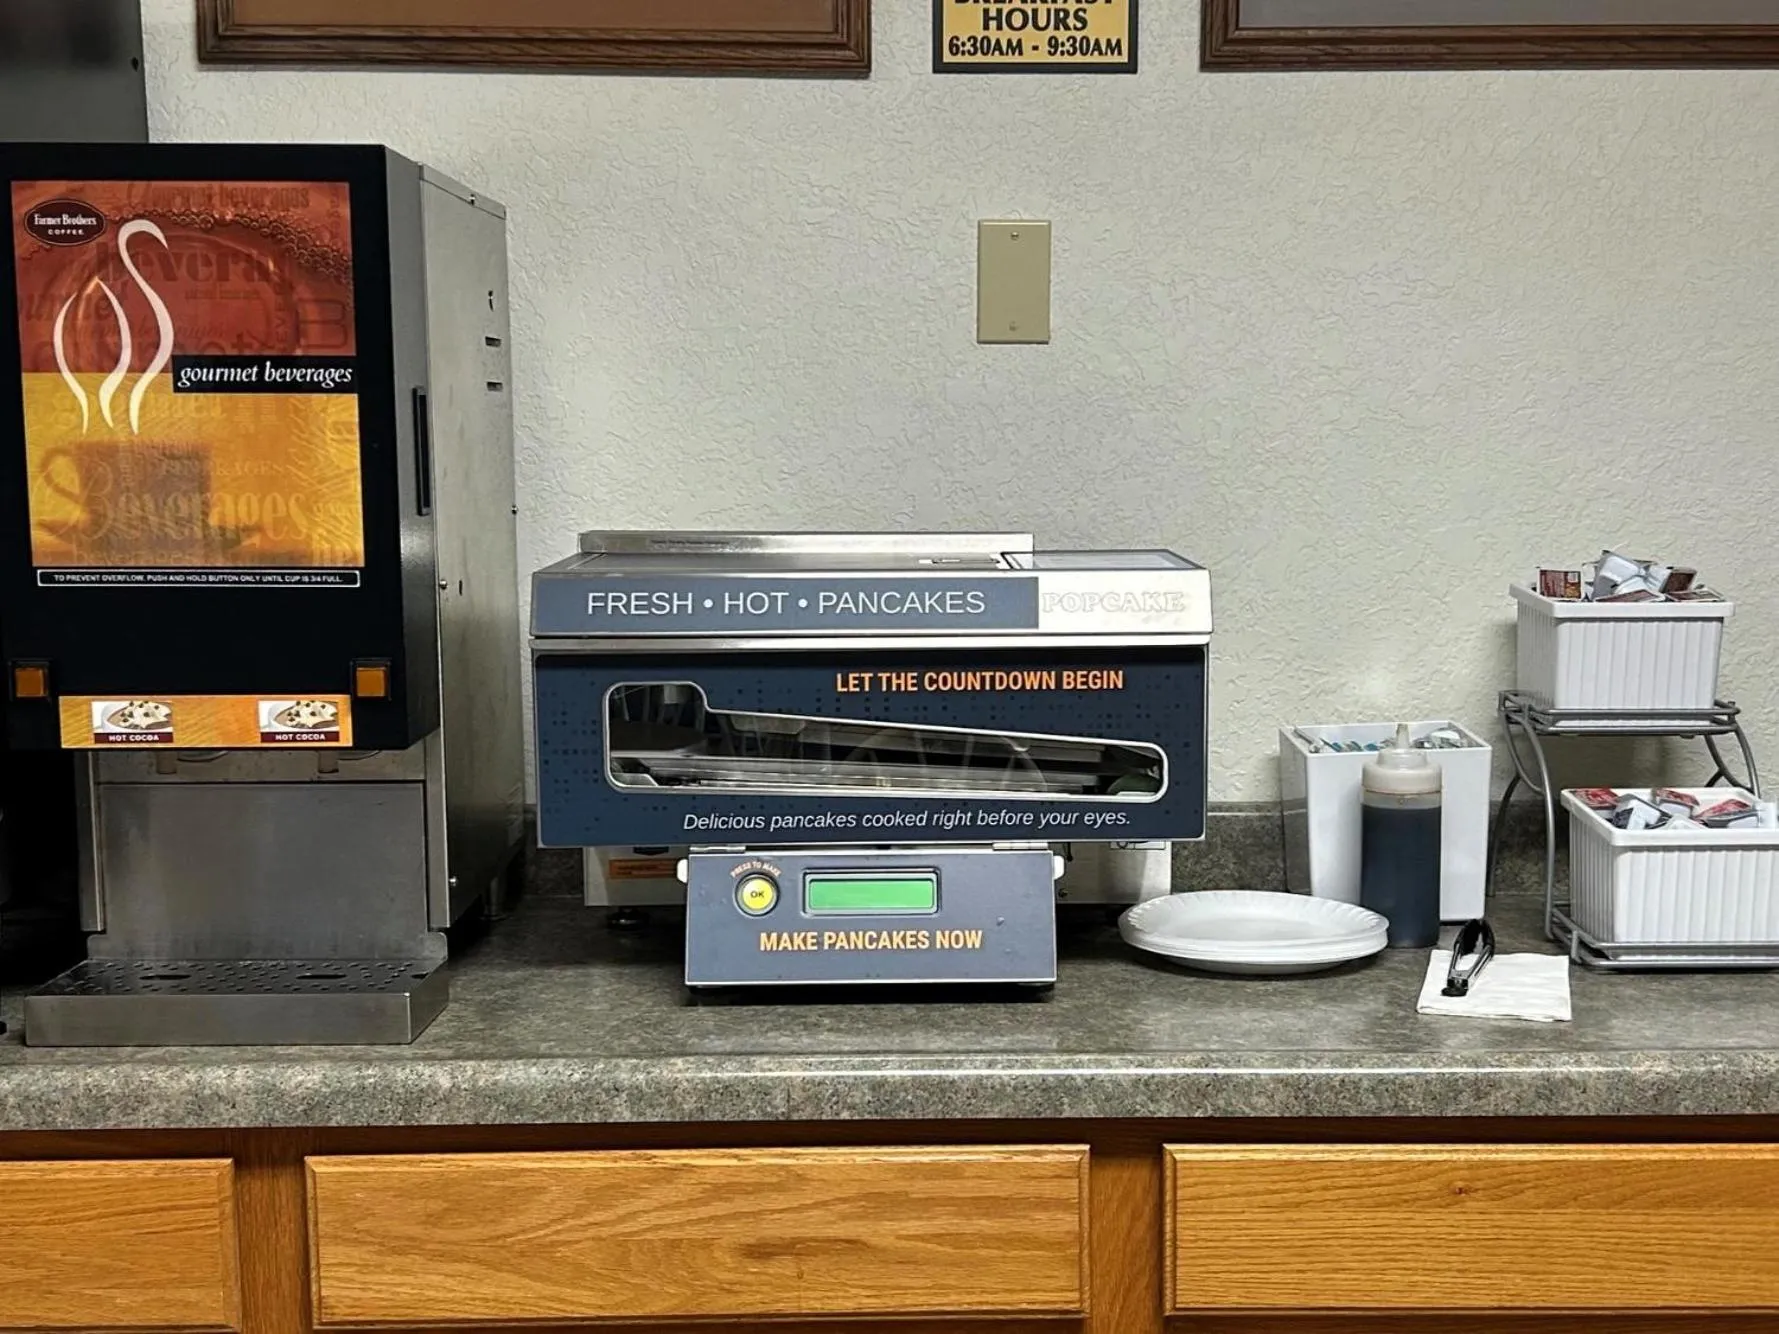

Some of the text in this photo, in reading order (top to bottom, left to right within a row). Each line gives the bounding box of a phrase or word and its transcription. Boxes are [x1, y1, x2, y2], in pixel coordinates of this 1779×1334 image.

[982, 7, 1088, 31] HOURS
[948, 35, 1024, 56] 6:30AM
[1047, 35, 1123, 56] 9:30AM
[62, 213, 97, 225] Brothers
[177, 361, 353, 388] gourmet beverages
[54, 574, 64, 582] TO
[66, 574, 100, 582] PREVENT
[147, 574, 167, 582] PUSH
[169, 574, 185, 582] AND
[186, 574, 206, 582] HOLD
[208, 574, 239, 582] BUTTON
[240, 574, 260, 582] ONLY
[262, 574, 283, 582] UNTIL
[285, 574, 300, 582] CUP
[587, 591, 985, 614] FRESH HOT PANCAKES
[1041, 591, 1186, 614] POPCAKE
[836, 670, 1124, 692] LET THE COUNTDOWN BEGIN
[109, 734, 160, 742] HOT COCOA
[275, 733, 326, 742] HOT COCOA
[683, 809, 1131, 832] Delicious pancakes cooked right before your eyes.
[759, 930, 983, 951] MAKE PANCAKES NOW
